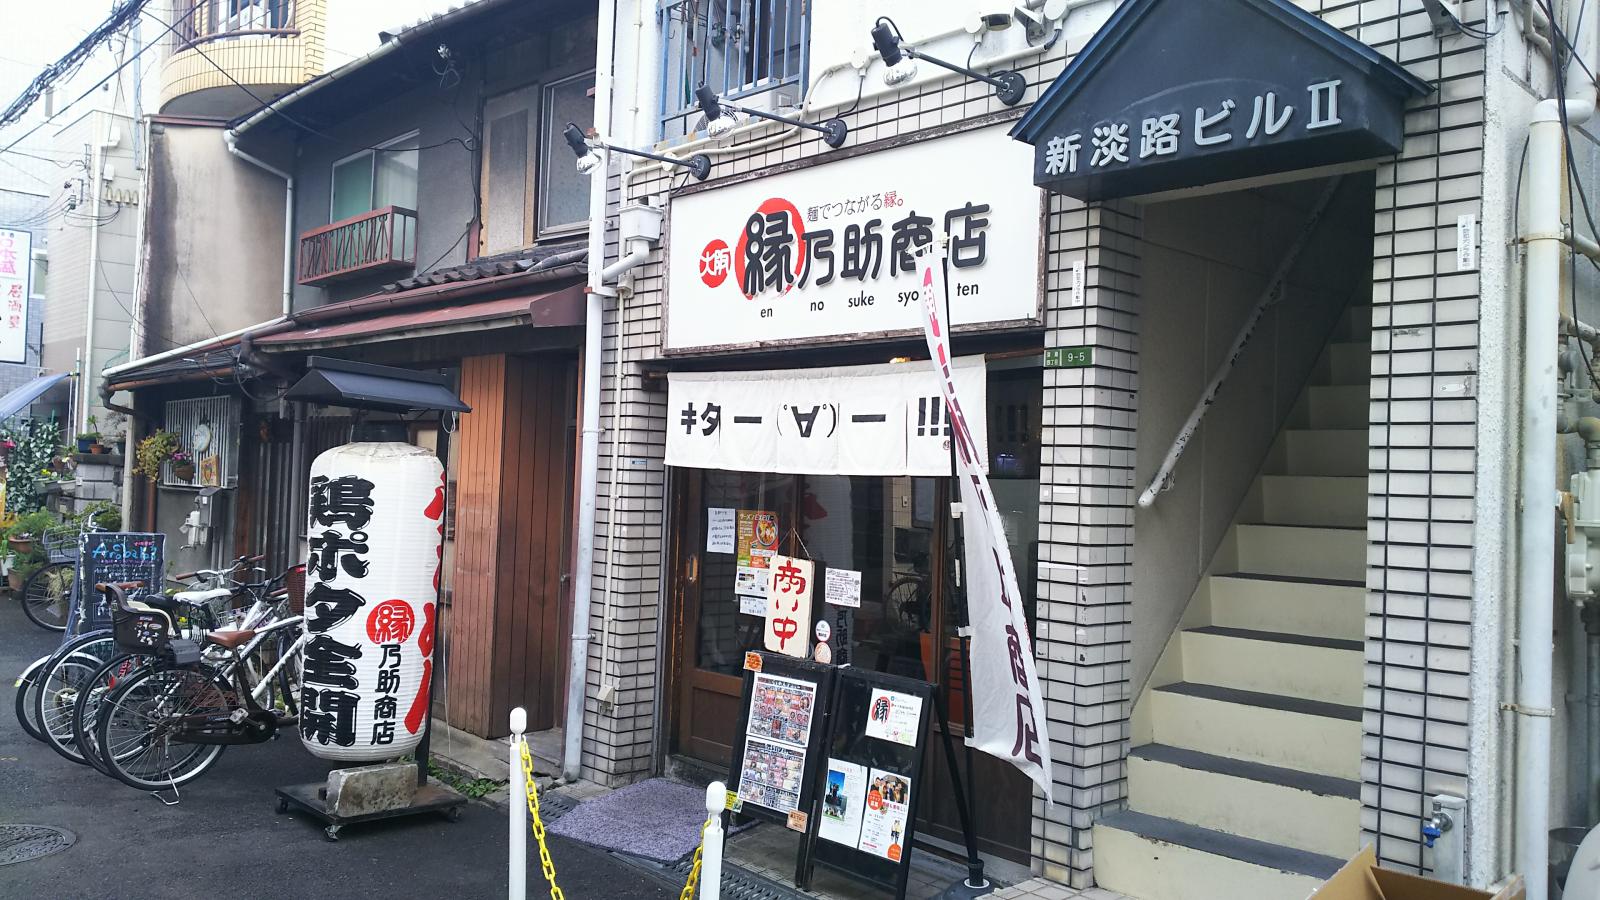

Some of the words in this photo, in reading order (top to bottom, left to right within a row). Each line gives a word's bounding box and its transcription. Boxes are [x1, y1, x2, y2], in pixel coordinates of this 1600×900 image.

[700, 248, 731, 277] 大阪
[743, 201, 990, 296] 縁乃助商店
[760, 307, 773, 318] en
[810, 299, 825, 312] no
[848, 290, 875, 308] suke
[956, 281, 980, 297] ten
[1067, 352, 1085, 362] 9-5
[772, 560, 807, 650] 商い中
[368, 603, 411, 746] 縁乃助商店
